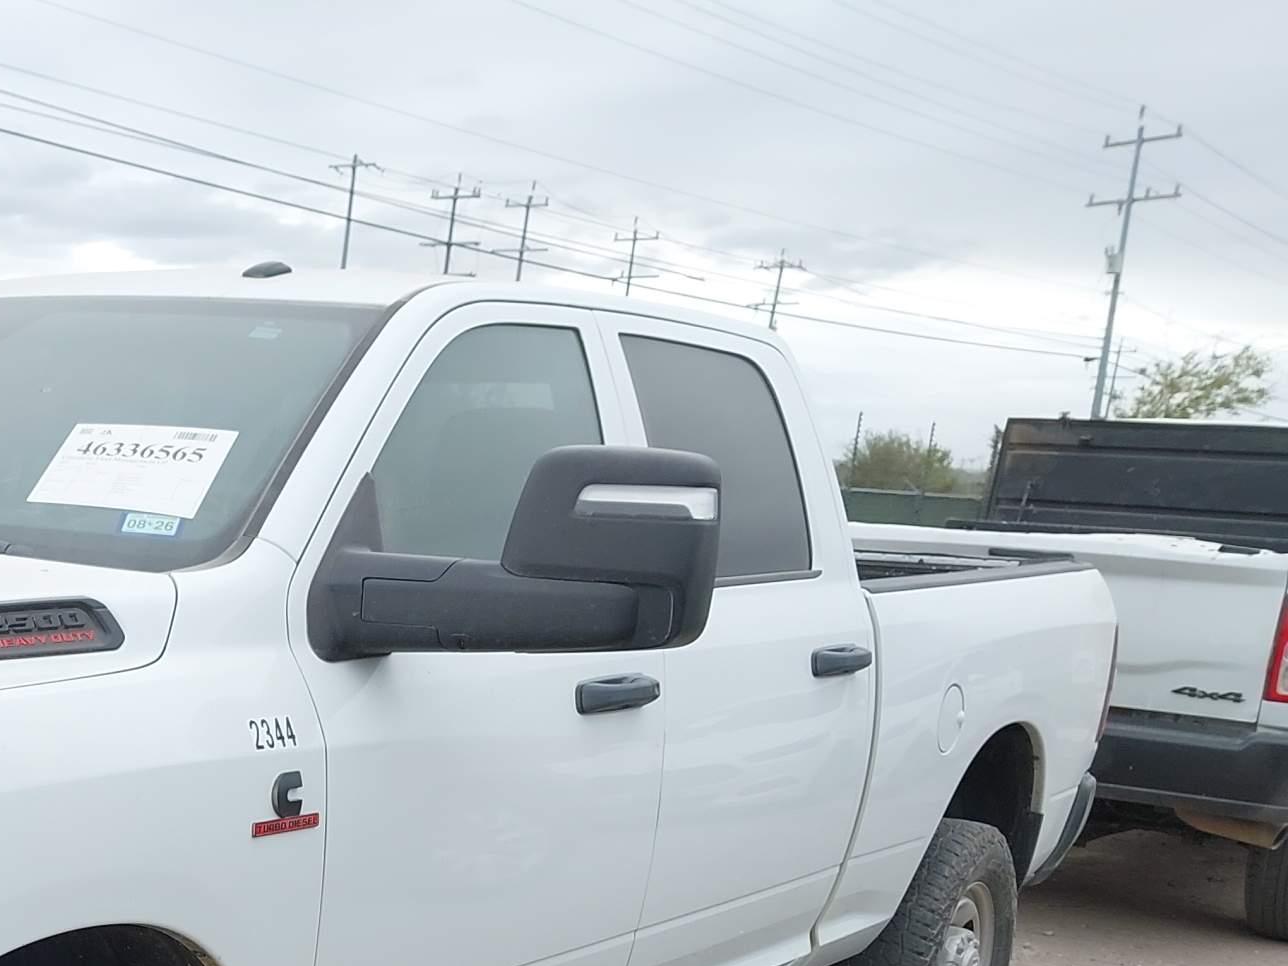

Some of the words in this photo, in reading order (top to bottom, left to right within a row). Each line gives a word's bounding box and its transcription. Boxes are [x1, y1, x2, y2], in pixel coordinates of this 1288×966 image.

[77, 441, 207, 464] 46336565
[49, 630, 96, 645] DUTY
[1171, 686, 1246, 703] 4x4
[249, 716, 297, 750] 2344
[257, 819, 288, 836] TURBO
[288, 814, 319, 831] DIESEL
